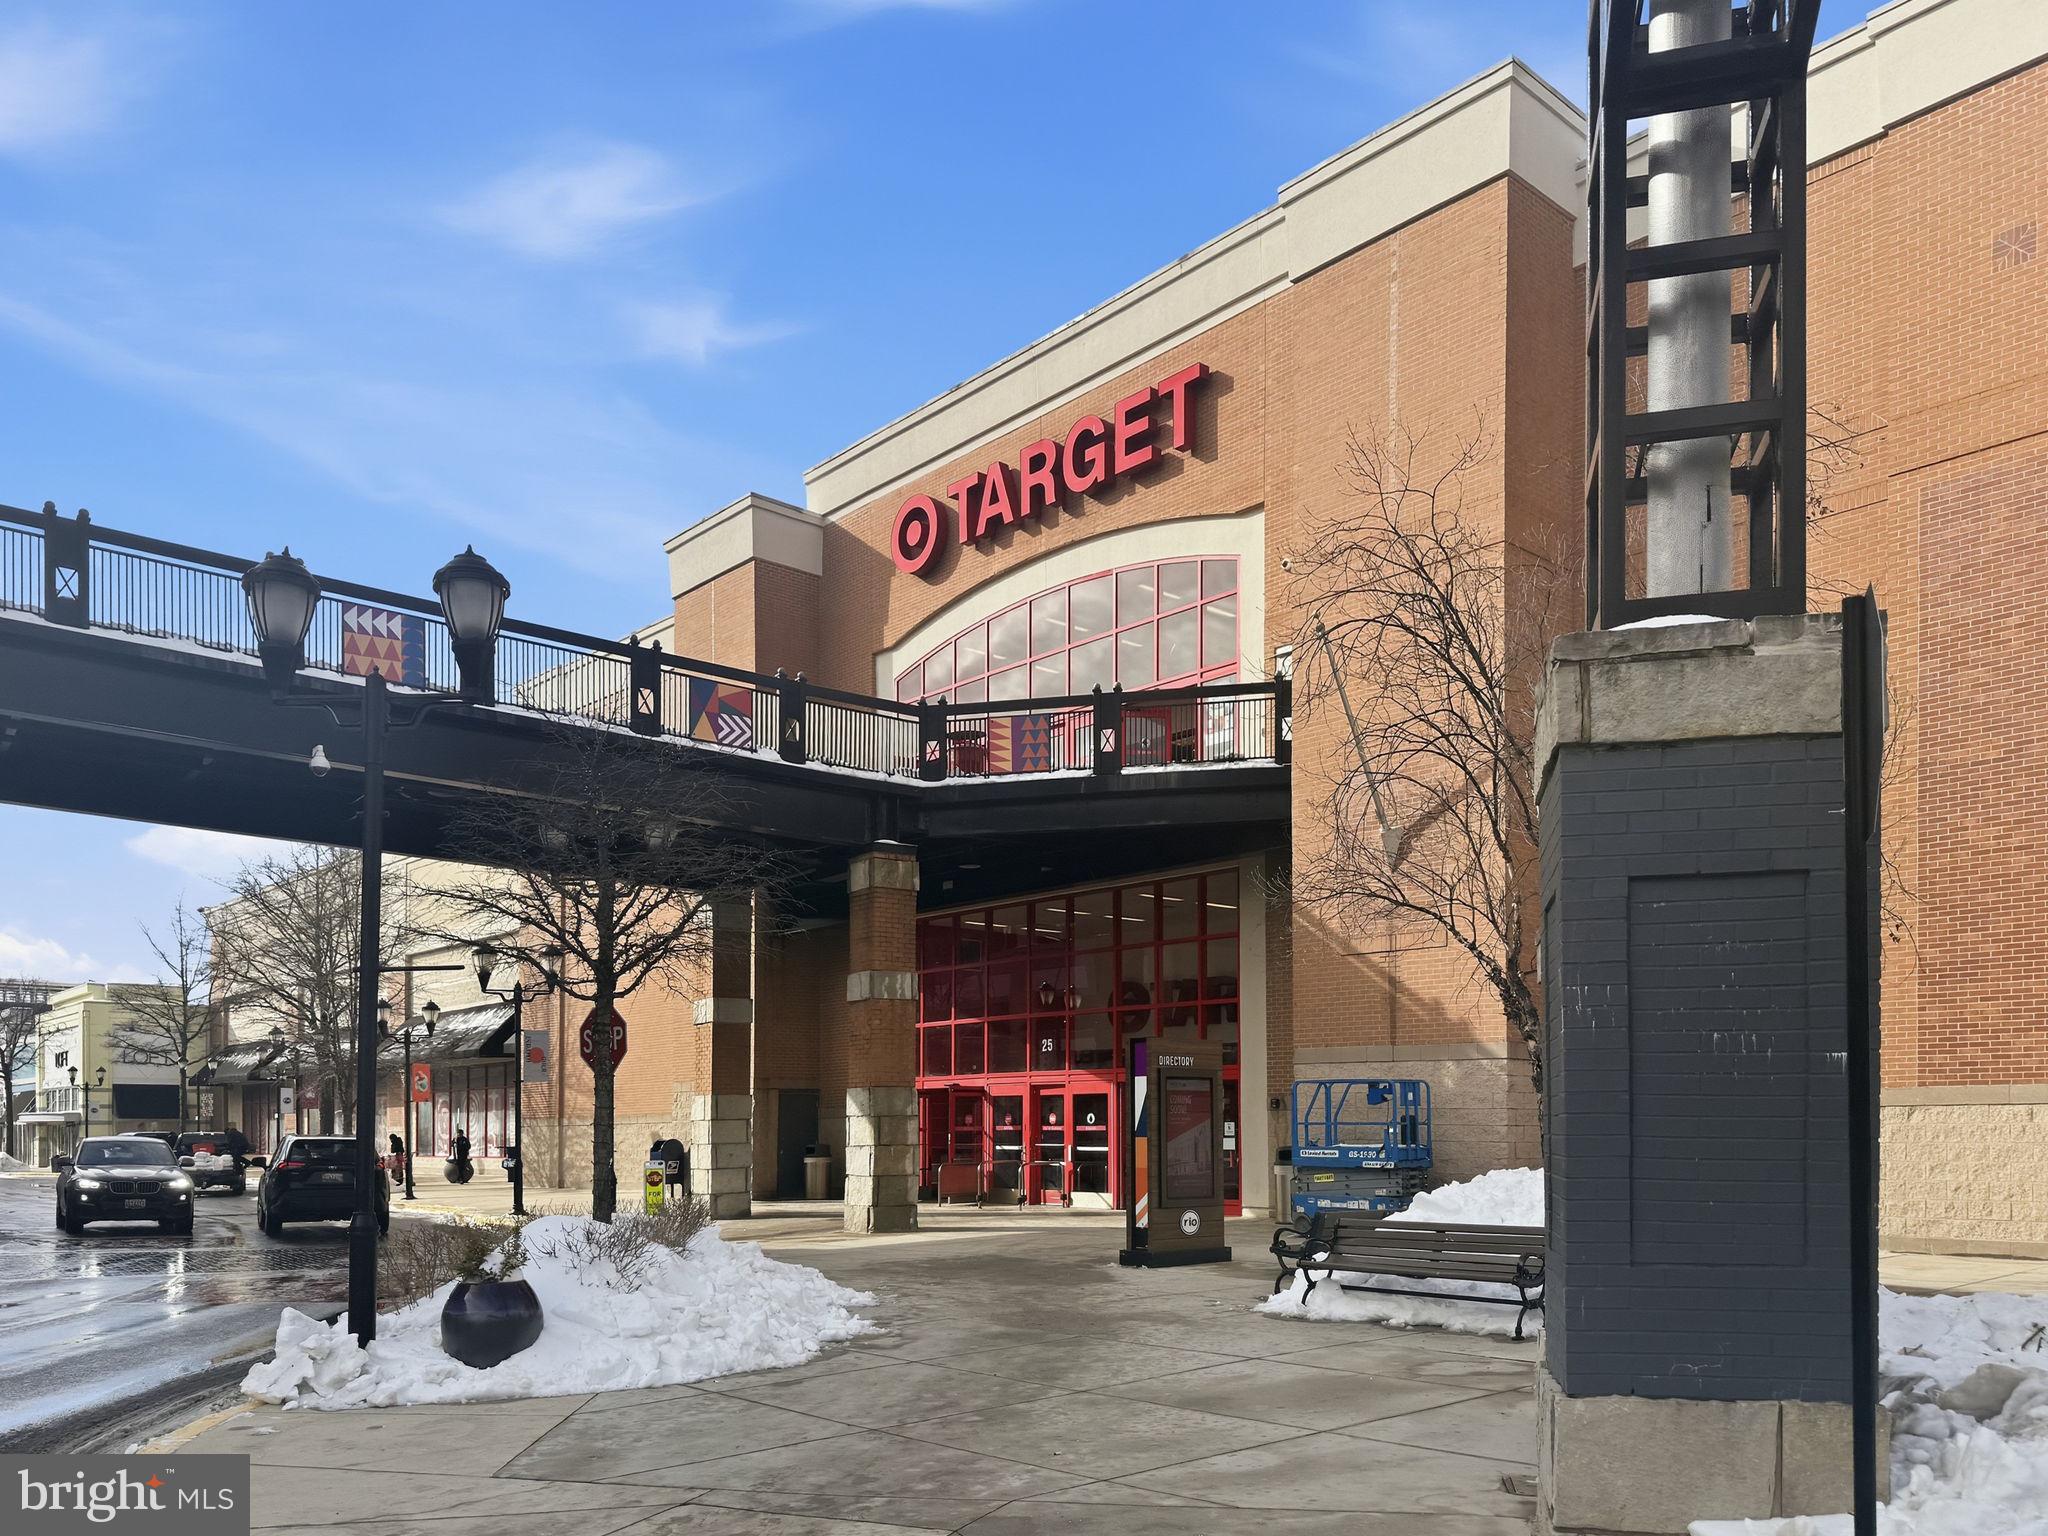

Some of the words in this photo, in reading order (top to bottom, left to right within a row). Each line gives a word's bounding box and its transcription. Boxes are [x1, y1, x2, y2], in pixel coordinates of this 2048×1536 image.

[947, 362, 1209, 545] TARGET
[583, 1026, 623, 1053] SP
[1042, 1038, 1053, 1052] 25
[1158, 1055, 1194, 1067] DIRECTORY
[1183, 1217, 1198, 1227] rio
